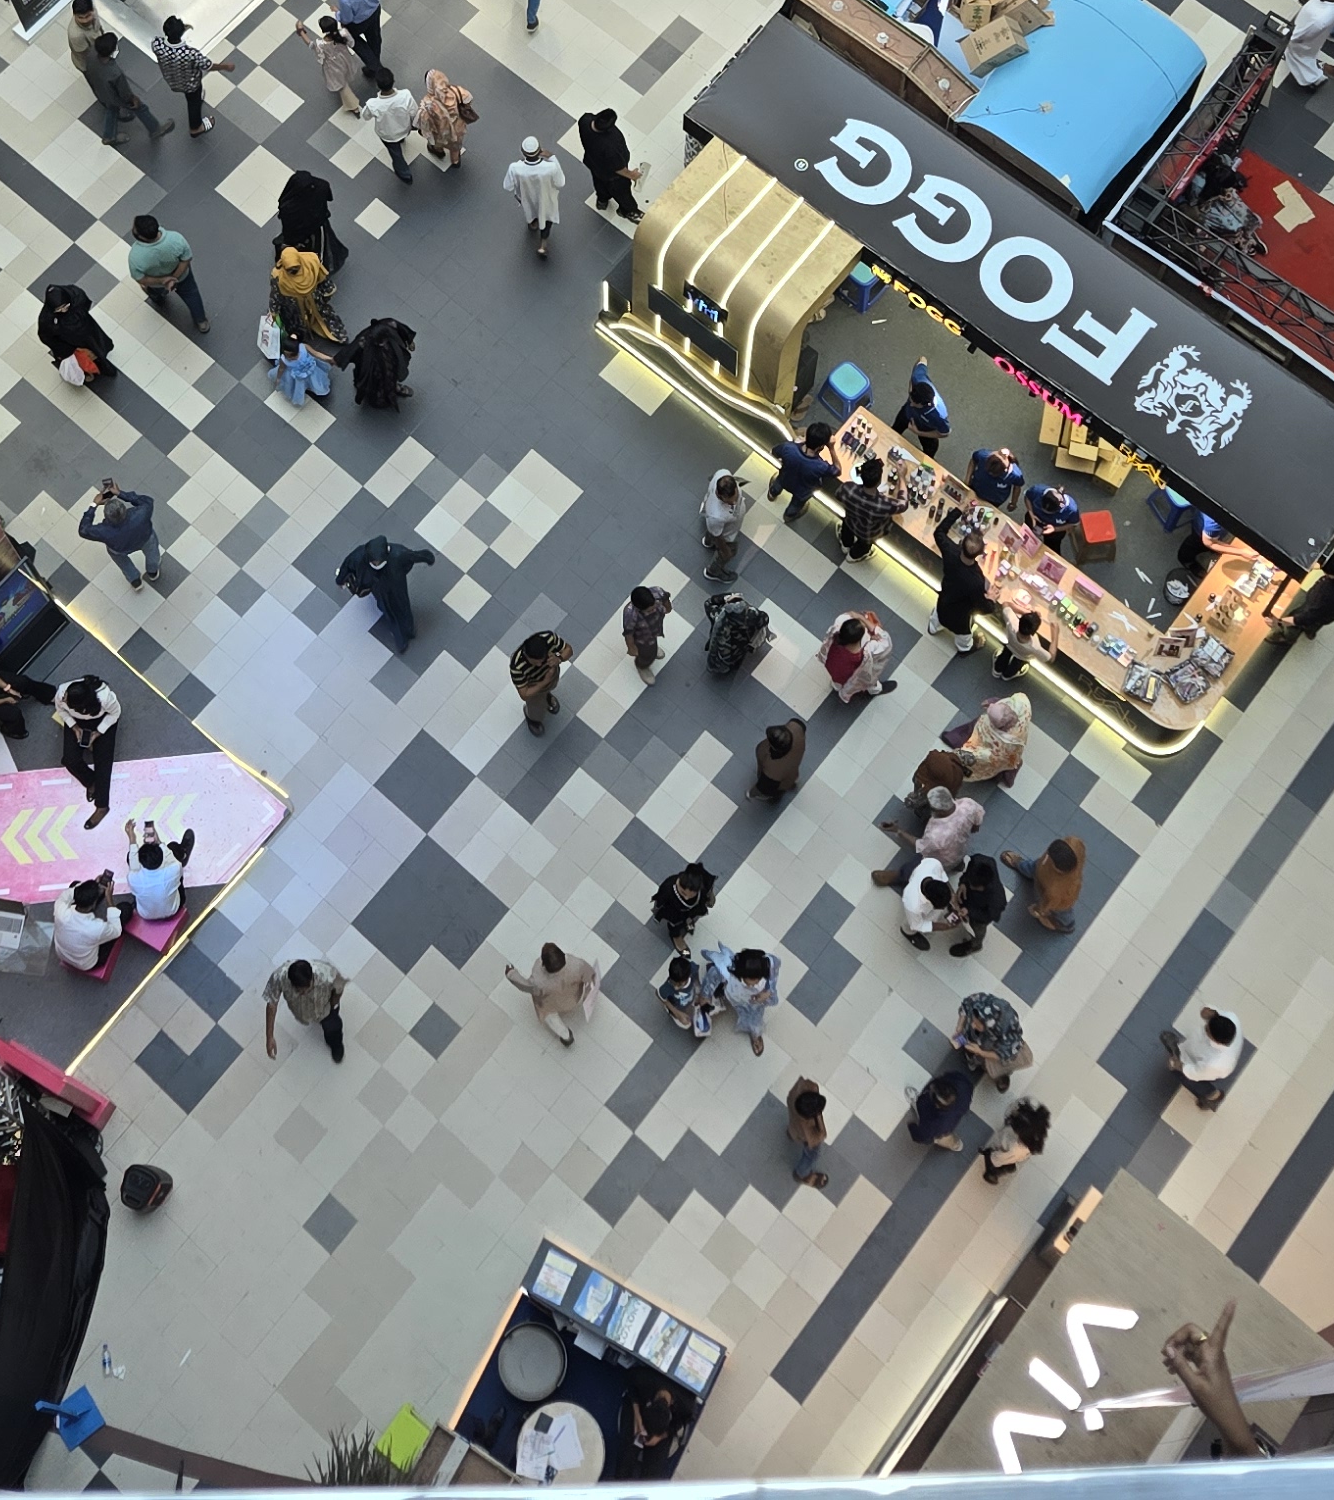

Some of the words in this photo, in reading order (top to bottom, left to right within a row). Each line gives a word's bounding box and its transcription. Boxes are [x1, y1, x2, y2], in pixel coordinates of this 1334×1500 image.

[814, 117, 1158, 386] FOGG
[893, 278, 963, 338] FOGG
[993, 356, 1083, 426] OSSUM
